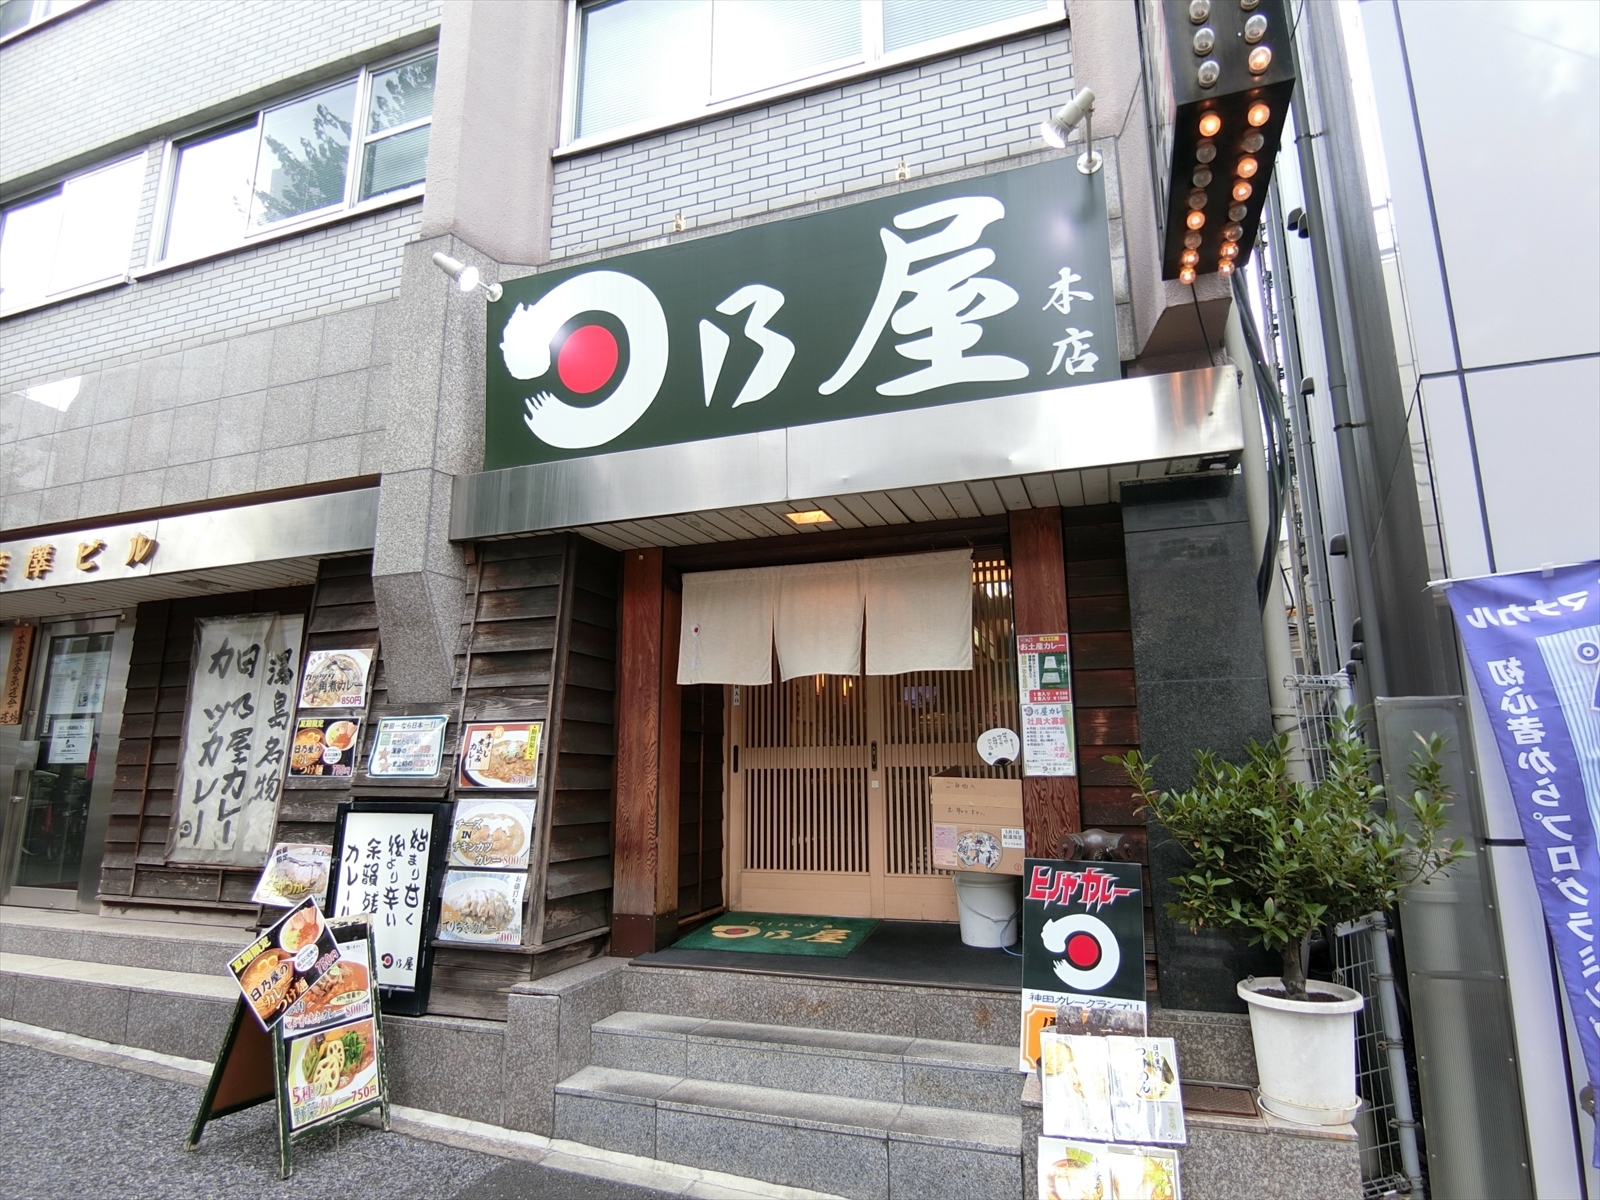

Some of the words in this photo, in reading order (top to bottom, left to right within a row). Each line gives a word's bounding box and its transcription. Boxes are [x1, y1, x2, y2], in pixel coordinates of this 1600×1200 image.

[1042, 266, 1099, 378] 本店
[1020, 642, 1066, 651] お土産カレー
[319, 680, 363, 693] 角煮カレー
[341, 696, 361, 705] 850円
[455, 818, 483, 830] チーズ
[461, 831, 472, 839] IN
[452, 842, 494, 852] チキンカツ
[351, 1084, 377, 1102] 750円
